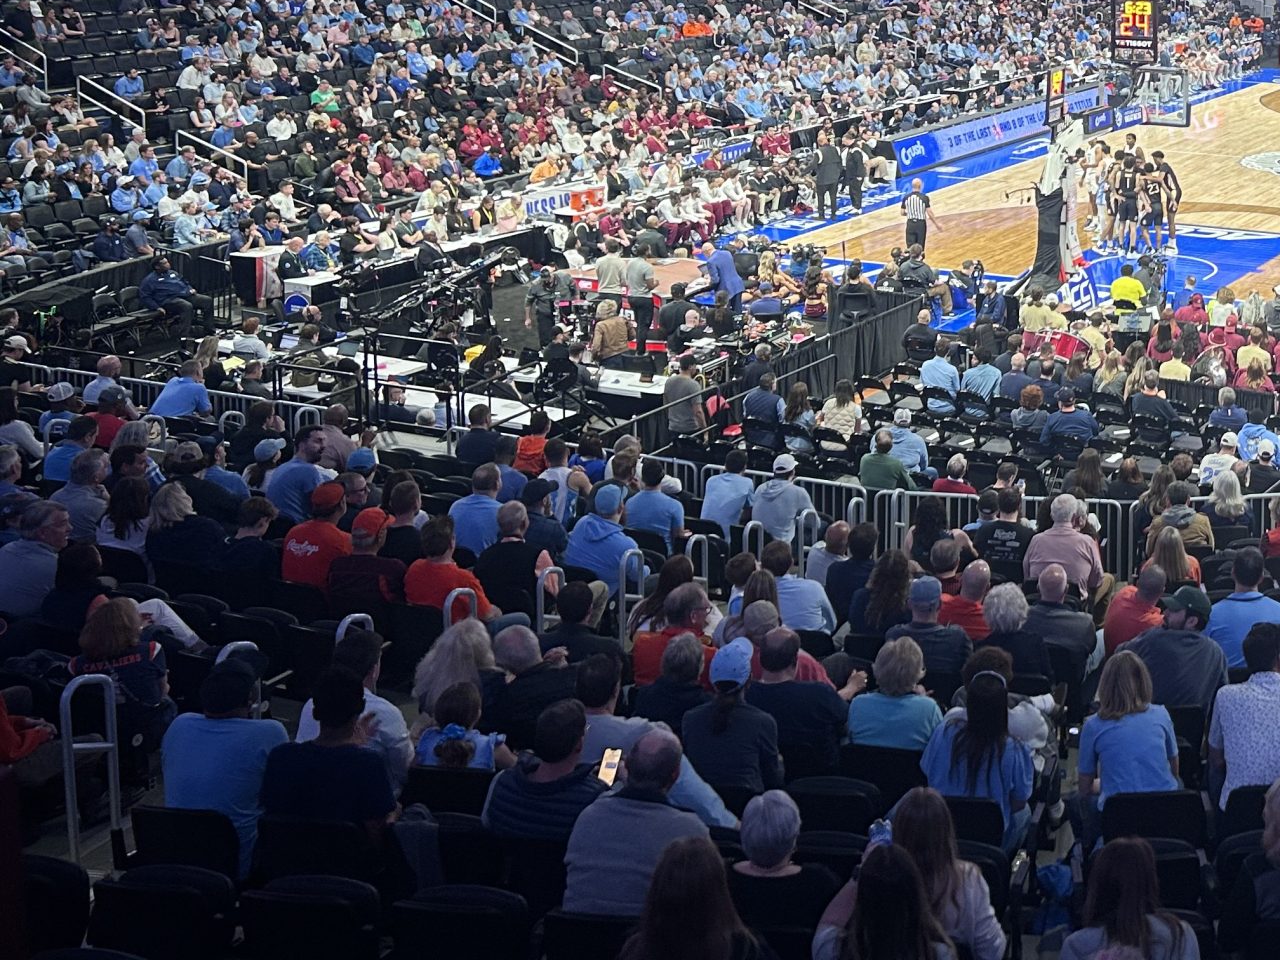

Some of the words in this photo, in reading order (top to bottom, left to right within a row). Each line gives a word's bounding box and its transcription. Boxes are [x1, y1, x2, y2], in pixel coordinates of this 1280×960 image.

[1124, 1, 1152, 15] 6:23
[1120, 14, 1149, 37] 24
[954, 136, 962, 147] OF
[964, 132, 975, 144] THE
[976, 128, 992, 141] LAST
[1018, 120, 1025, 130] OF
[1027, 116, 1037, 129] THE
[900, 140, 925, 166] Crush
[1148, 184, 1160, 194] 23
